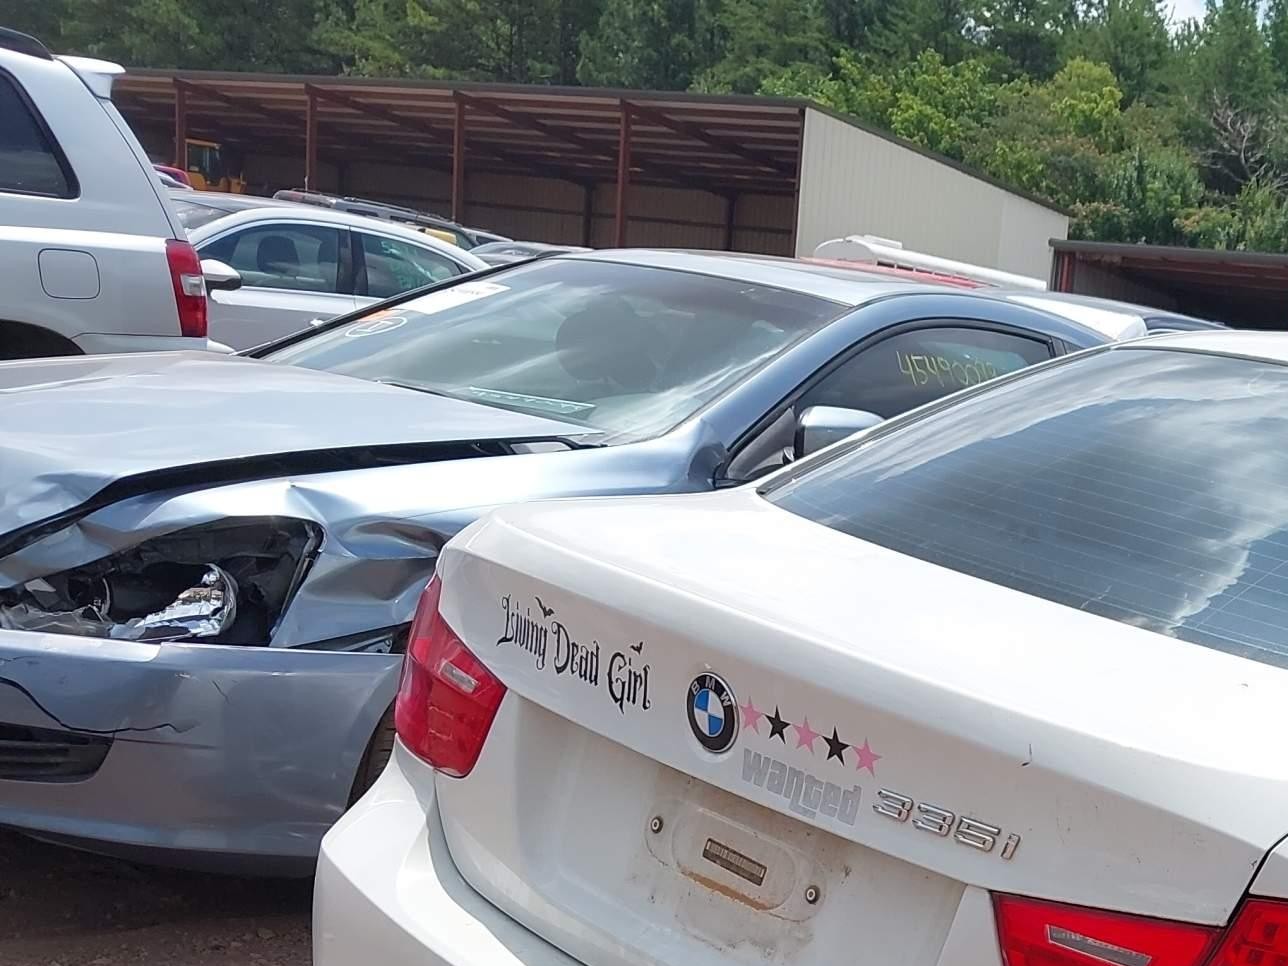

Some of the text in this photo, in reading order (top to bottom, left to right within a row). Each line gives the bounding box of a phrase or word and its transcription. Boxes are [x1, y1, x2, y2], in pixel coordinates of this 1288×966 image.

[496, 593, 652, 715] Living Dead Girl
[691, 675, 732, 708] BMW
[872, 787, 1021, 860] 335i
